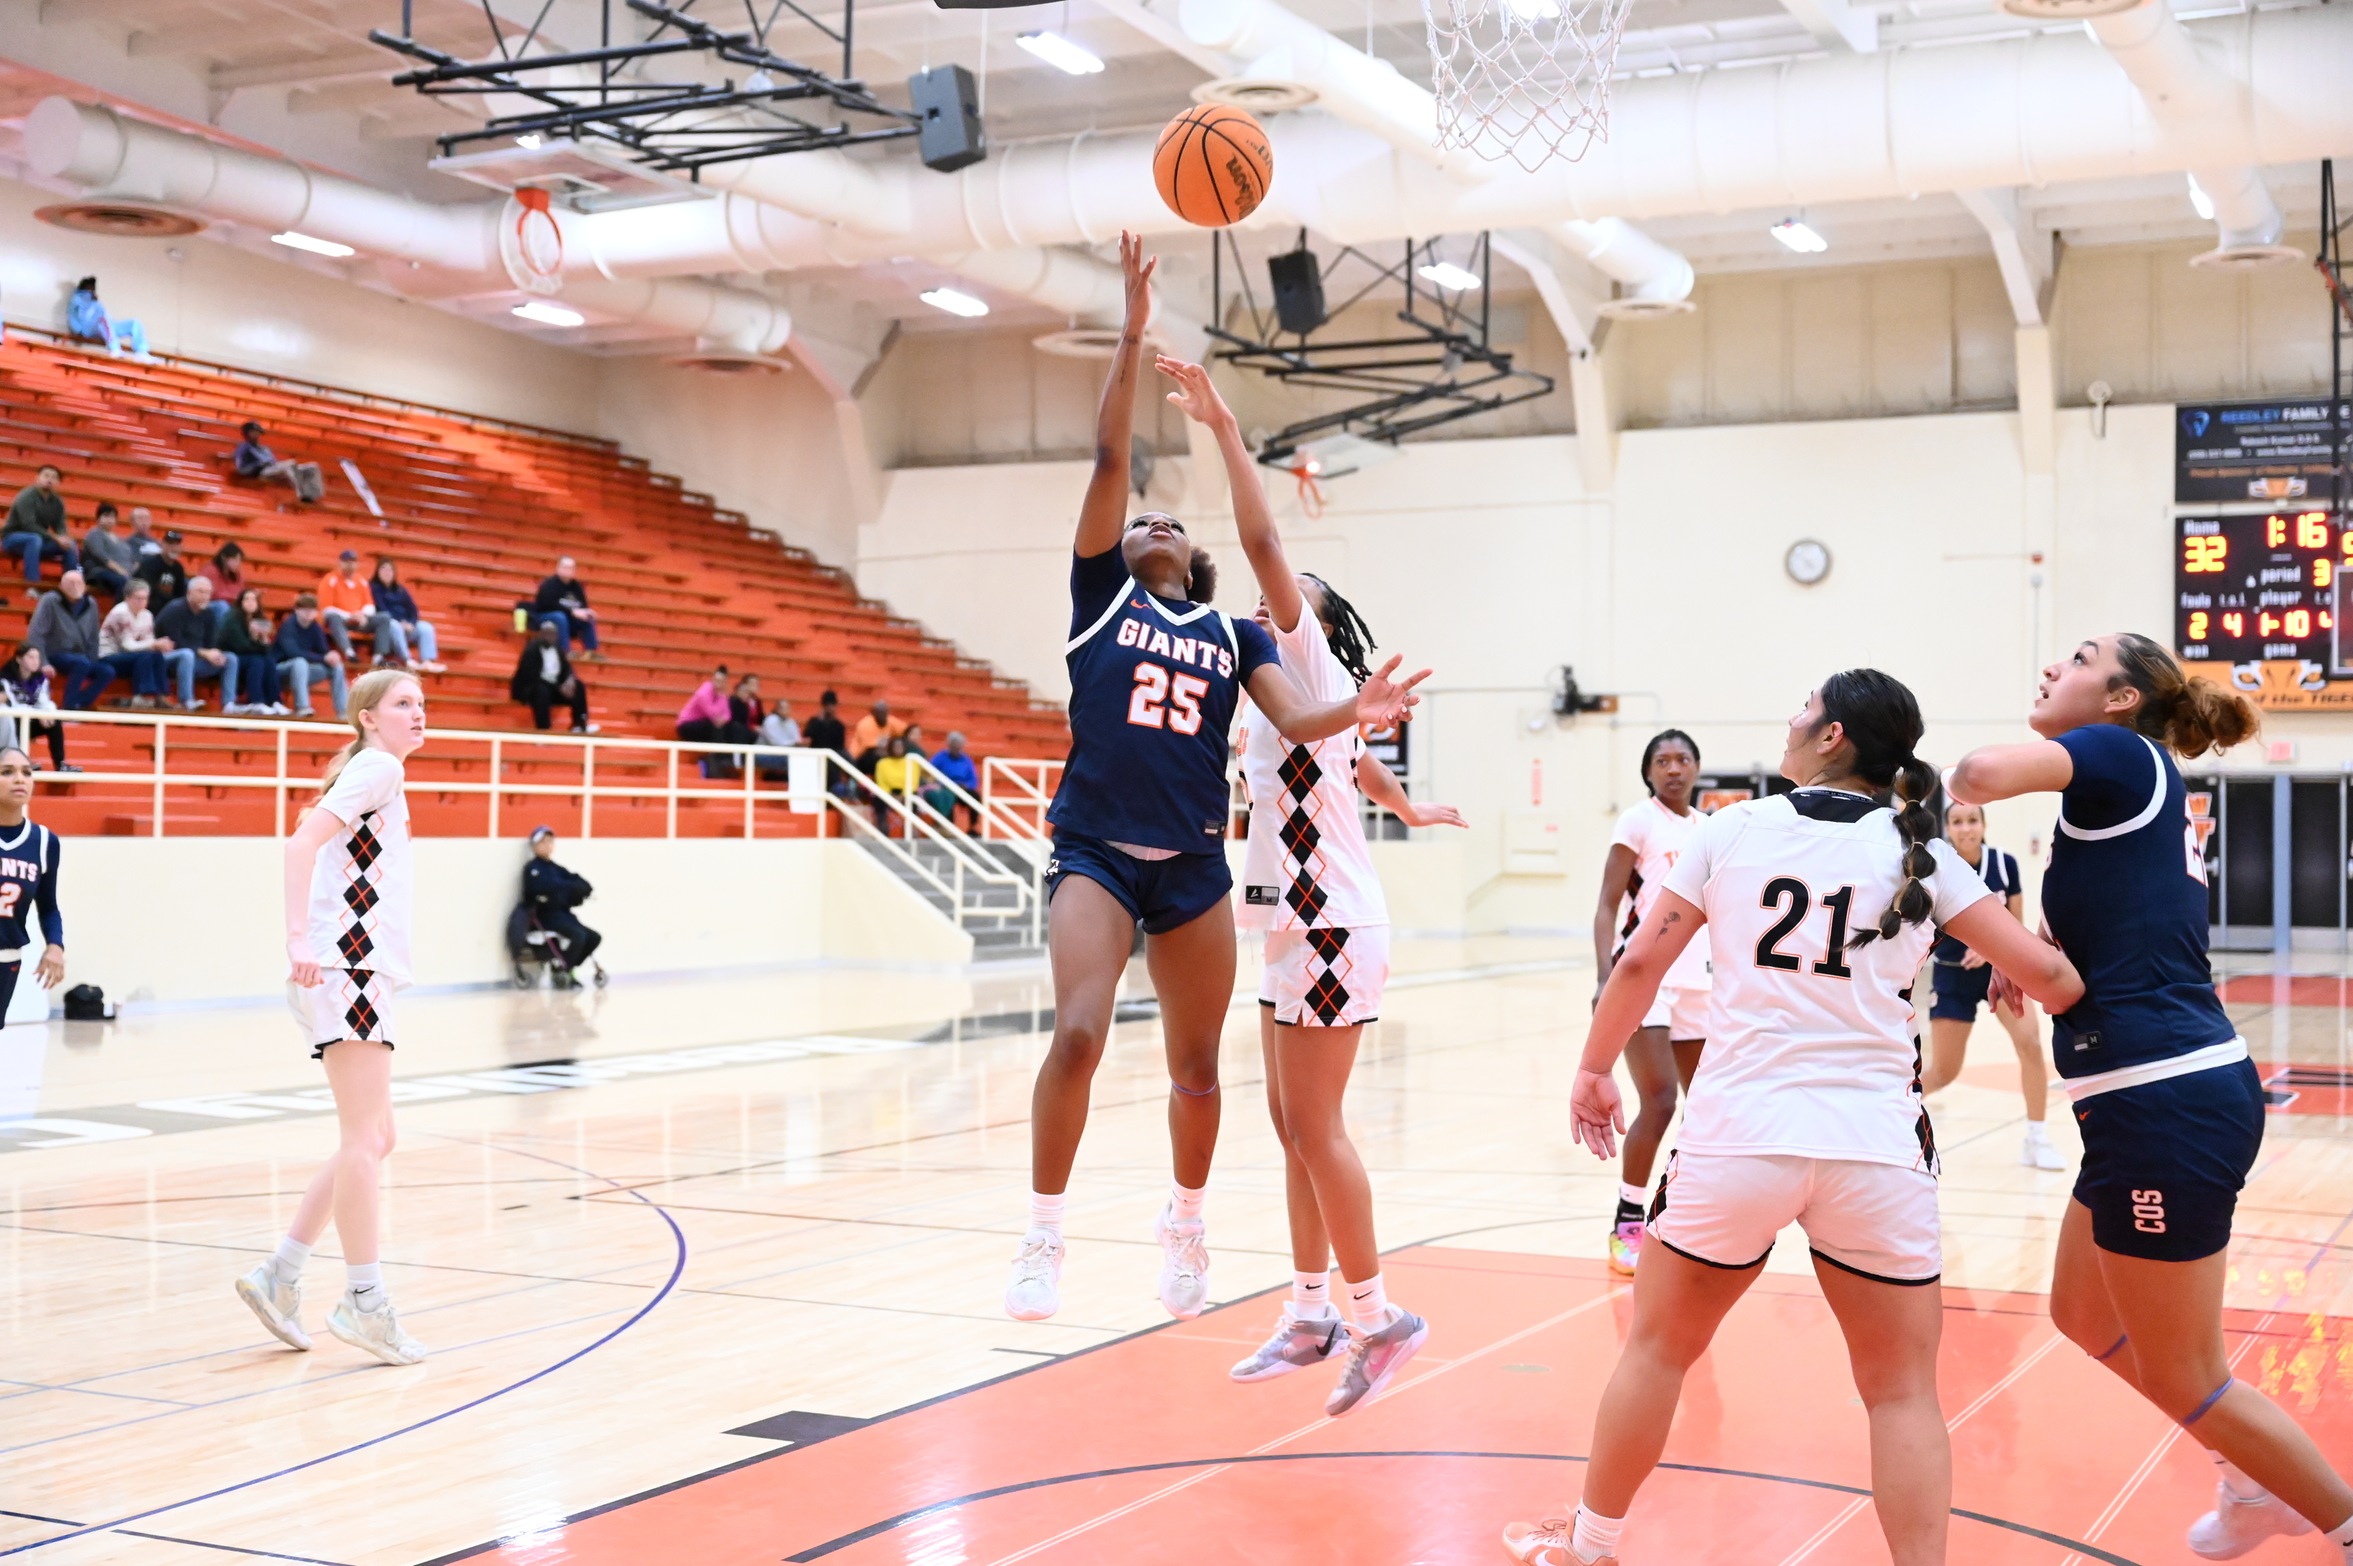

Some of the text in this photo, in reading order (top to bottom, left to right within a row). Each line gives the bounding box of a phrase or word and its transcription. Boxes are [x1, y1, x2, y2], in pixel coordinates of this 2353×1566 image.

[2282, 405, 2329, 421] FAMILY
[2184, 519, 2220, 536] Home
[2185, 536, 2226, 572] 32
[2261, 566, 2301, 585] period
[2313, 558, 2331, 586] 3
[2259, 589, 2301, 608] player
[2189, 612, 2208, 640] 2
[2223, 613, 2242, 637] 4
[1117, 618, 1233, 679] GIANTS
[1127, 661, 1209, 736] 25
[0, 856, 38, 882] NTS
[1754, 875, 1855, 980] 21
[2131, 1189, 2167, 1233] COS
